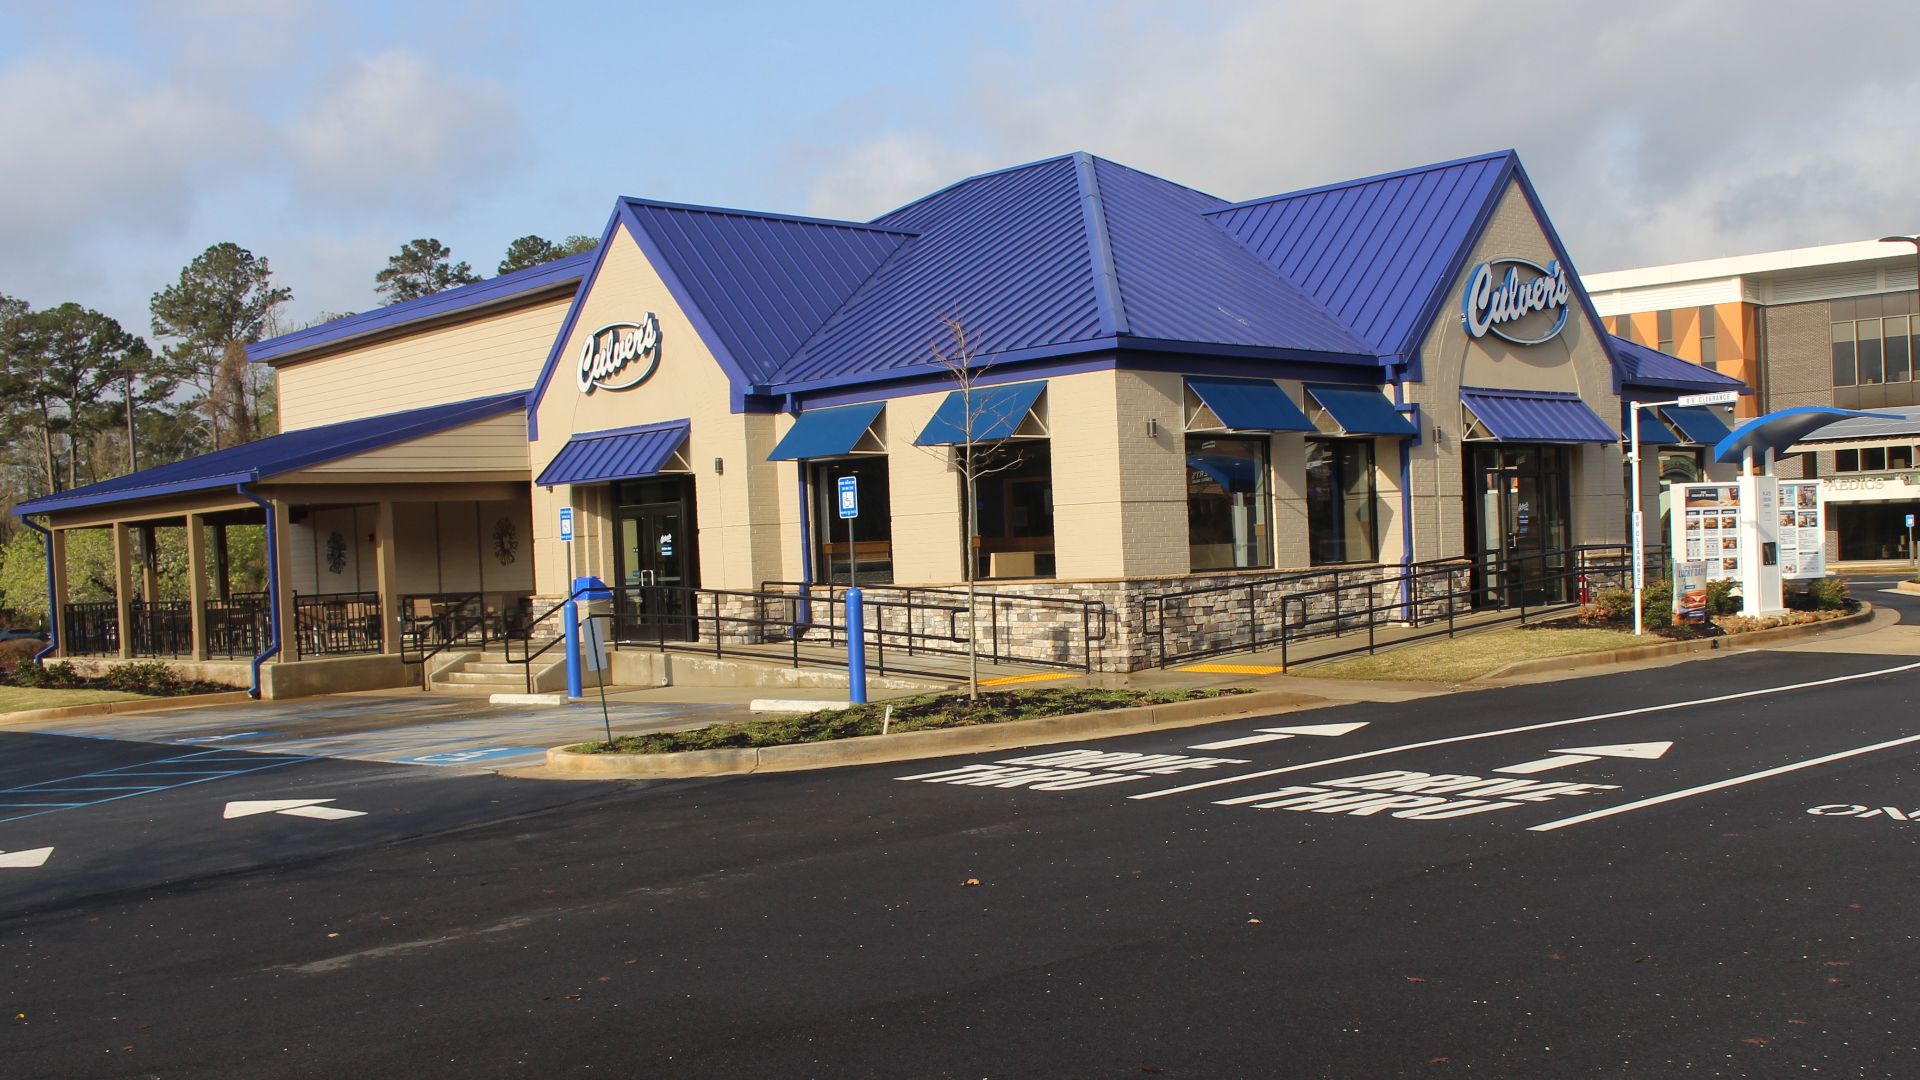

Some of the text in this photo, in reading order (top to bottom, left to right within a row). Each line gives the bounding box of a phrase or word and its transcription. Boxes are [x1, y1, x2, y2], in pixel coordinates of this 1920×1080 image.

[1463, 260, 1570, 338] Culver's
[577, 312, 659, 394] Culver's
[893, 764, 1151, 791] THRU
[994, 749, 1252, 775] DRIVE
[1211, 785, 1525, 820] THRU
[1311, 770, 1622, 802] DRIVE
